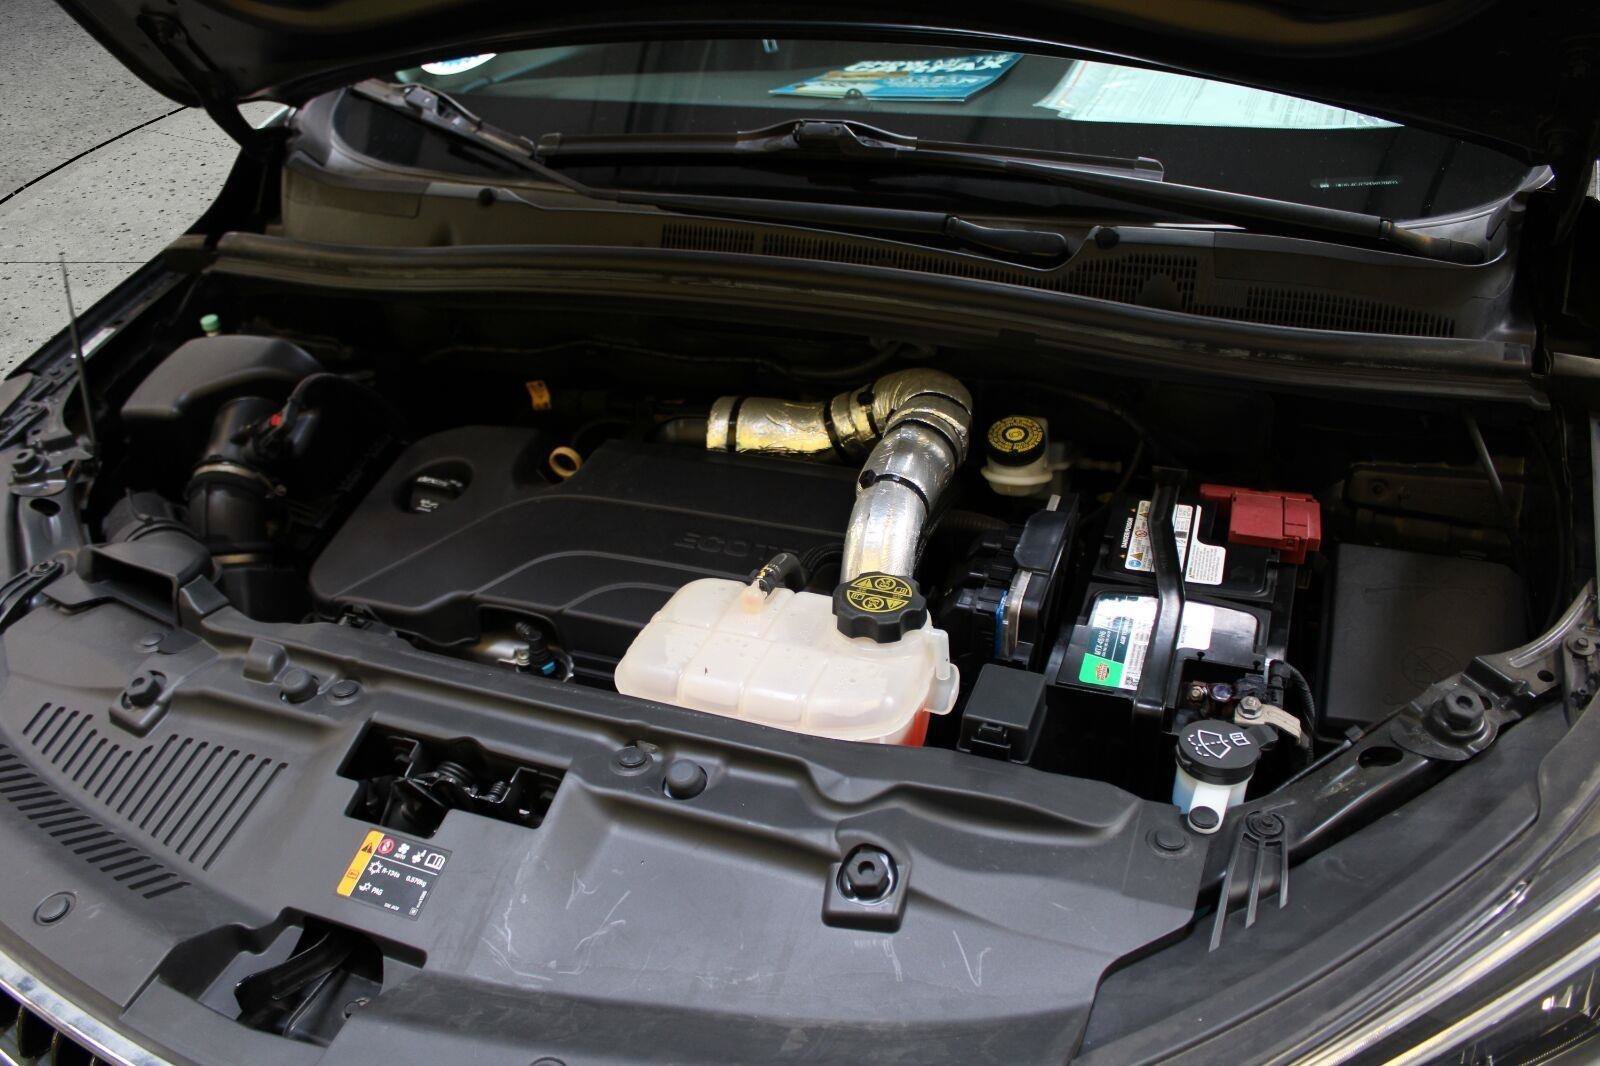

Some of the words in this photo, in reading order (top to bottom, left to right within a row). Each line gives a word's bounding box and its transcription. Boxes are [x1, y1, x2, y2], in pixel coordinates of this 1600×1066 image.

[672, 532, 799, 560] ECOT
[381, 868, 400, 878] R-134a
[371, 887, 384, 896] PAG
